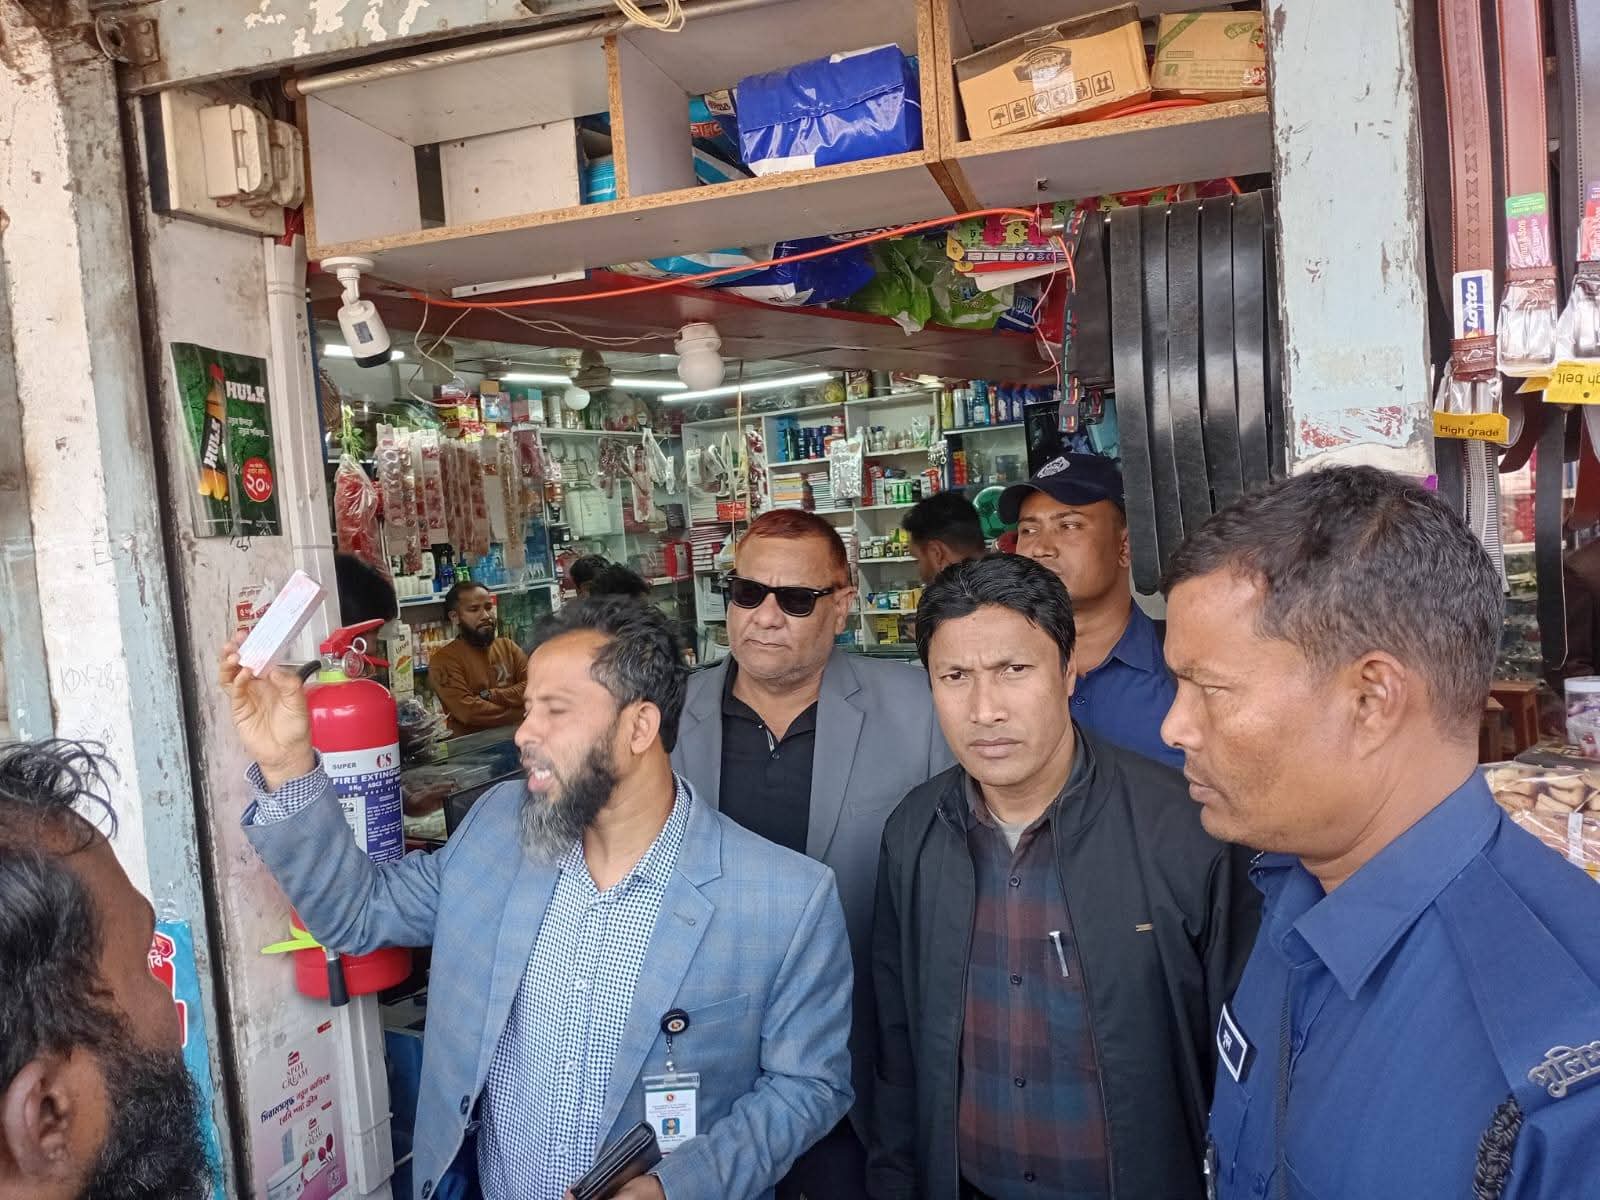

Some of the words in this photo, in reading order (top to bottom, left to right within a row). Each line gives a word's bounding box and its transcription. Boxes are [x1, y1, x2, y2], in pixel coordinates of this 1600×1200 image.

[1465, 280, 1479, 328] Lotto
[1557, 373, 1584, 385] belt
[1587, 372, 1600, 387] gh
[225, 380, 266, 403] HULK
[1440, 424, 1465, 436] High
[1467, 425, 1500, 437] grade
[203, 418, 221, 469] HULK
[332, 762, 357, 770] SUPER
[377, 753, 392, 768] CS
[333, 777, 358, 785] FIRE
[361, 769, 400, 782] EXTINGU
[287, 1062, 305, 1075] SPOT
[281, 1067, 308, 1089] CREAM
